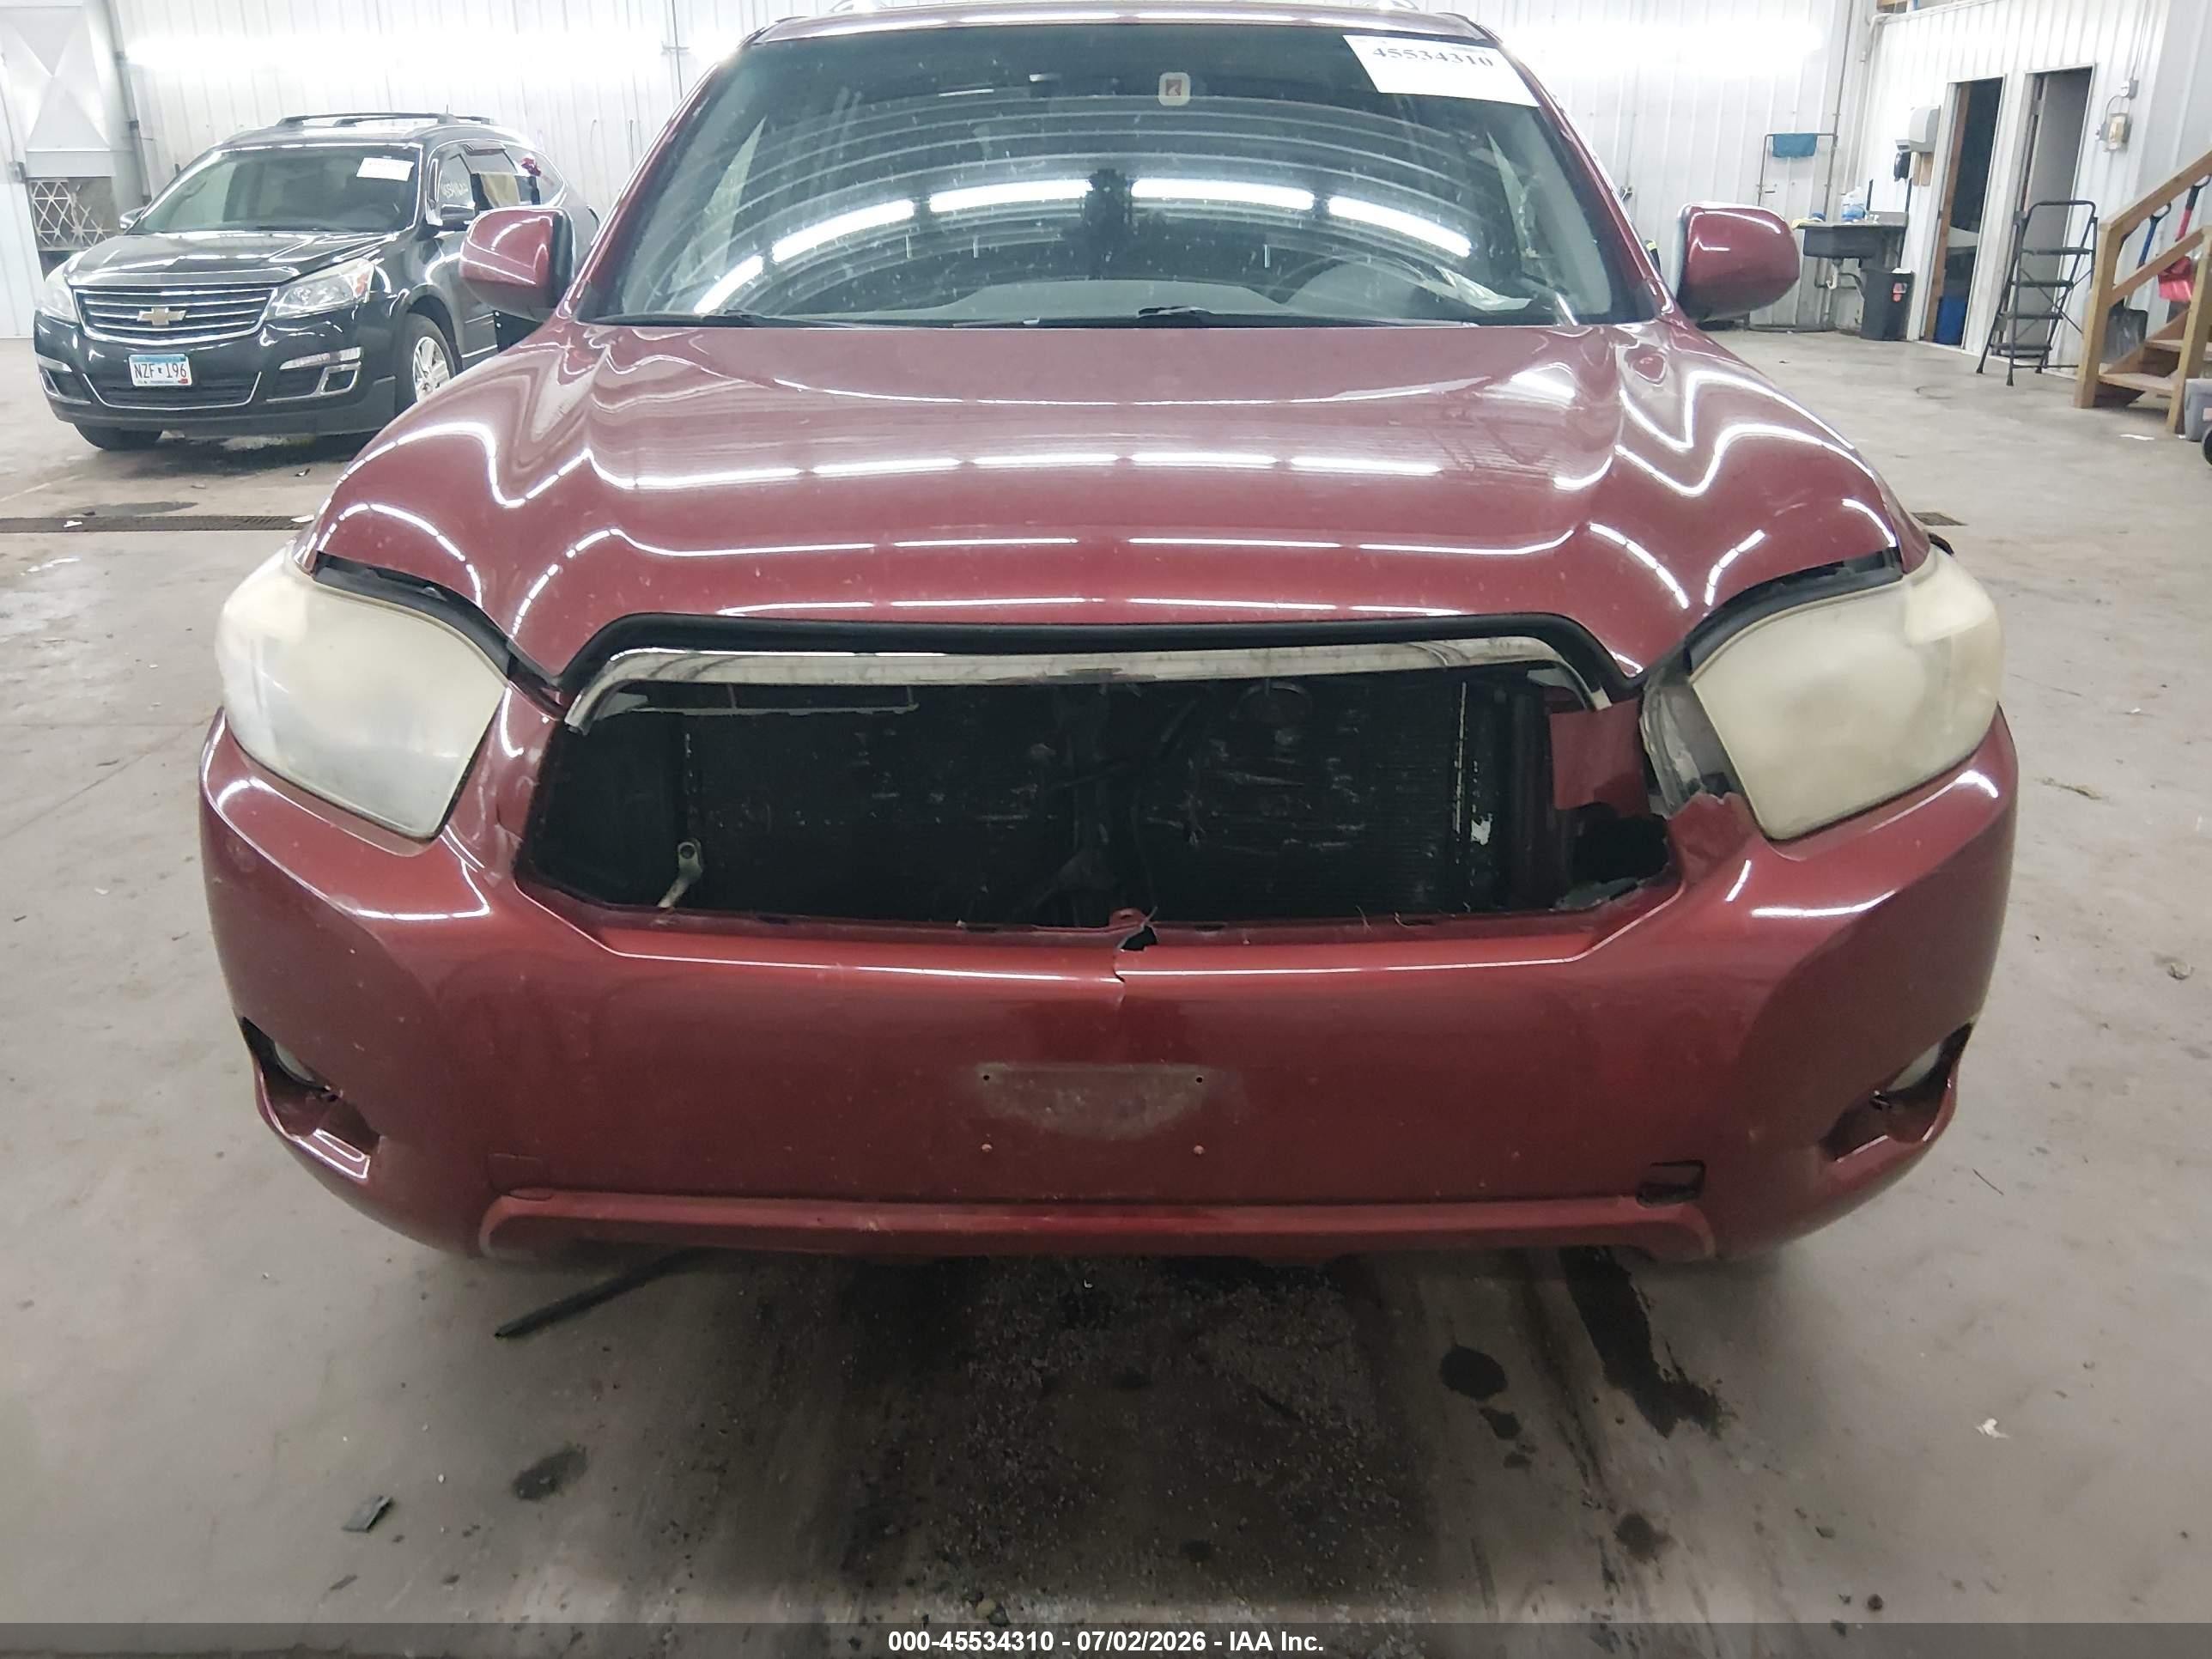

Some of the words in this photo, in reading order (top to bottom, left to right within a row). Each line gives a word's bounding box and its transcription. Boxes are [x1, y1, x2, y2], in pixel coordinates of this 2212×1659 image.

[1373, 47, 1494, 67] 45534310
[134, 363, 155, 379] NZF
[166, 362, 187, 378] 196
